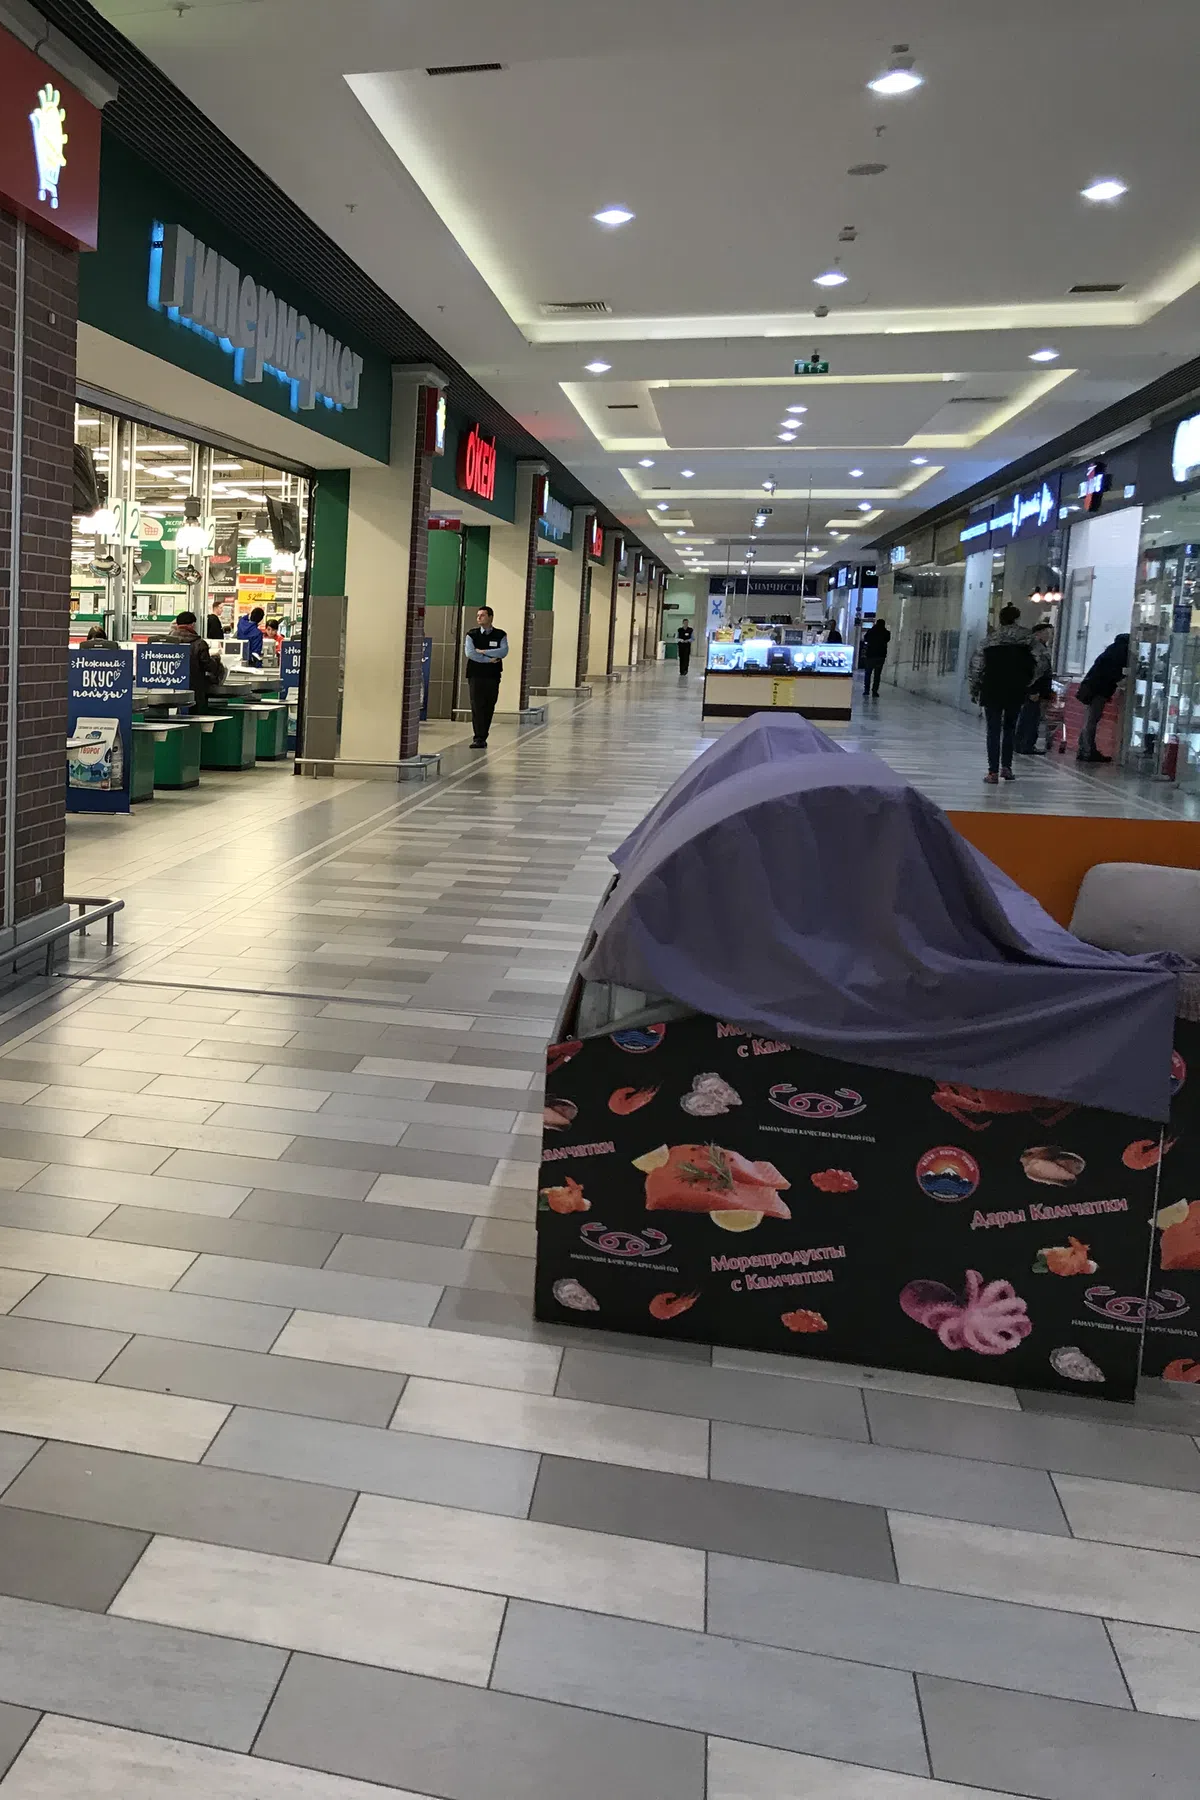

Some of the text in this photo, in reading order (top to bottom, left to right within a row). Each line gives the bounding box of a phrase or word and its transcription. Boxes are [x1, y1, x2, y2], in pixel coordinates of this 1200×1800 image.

[160, 222, 363, 410] Гипермаркет
[76, 657, 120, 668] Нежный
[144, 650, 180, 660] Нежный
[150, 660, 175, 675] ВКУС
[82, 670, 113, 687] ВКУС
[142, 675, 181, 685] пользы
[72, 688, 122, 701] пользы
[799, 1129, 831, 1138] КАЧЕСТВО
[832, 1132, 861, 1141] КРУГЛЫЙ
[541, 1141, 616, 1161] амчатки
[970, 1198, 1128, 1230] Дары Камчатки
[710, 1246, 846, 1273] Морепродукты
[731, 1269, 834, 1292] с Камчатки
[1115, 1324, 1149, 1335] КАЧЕСТ
